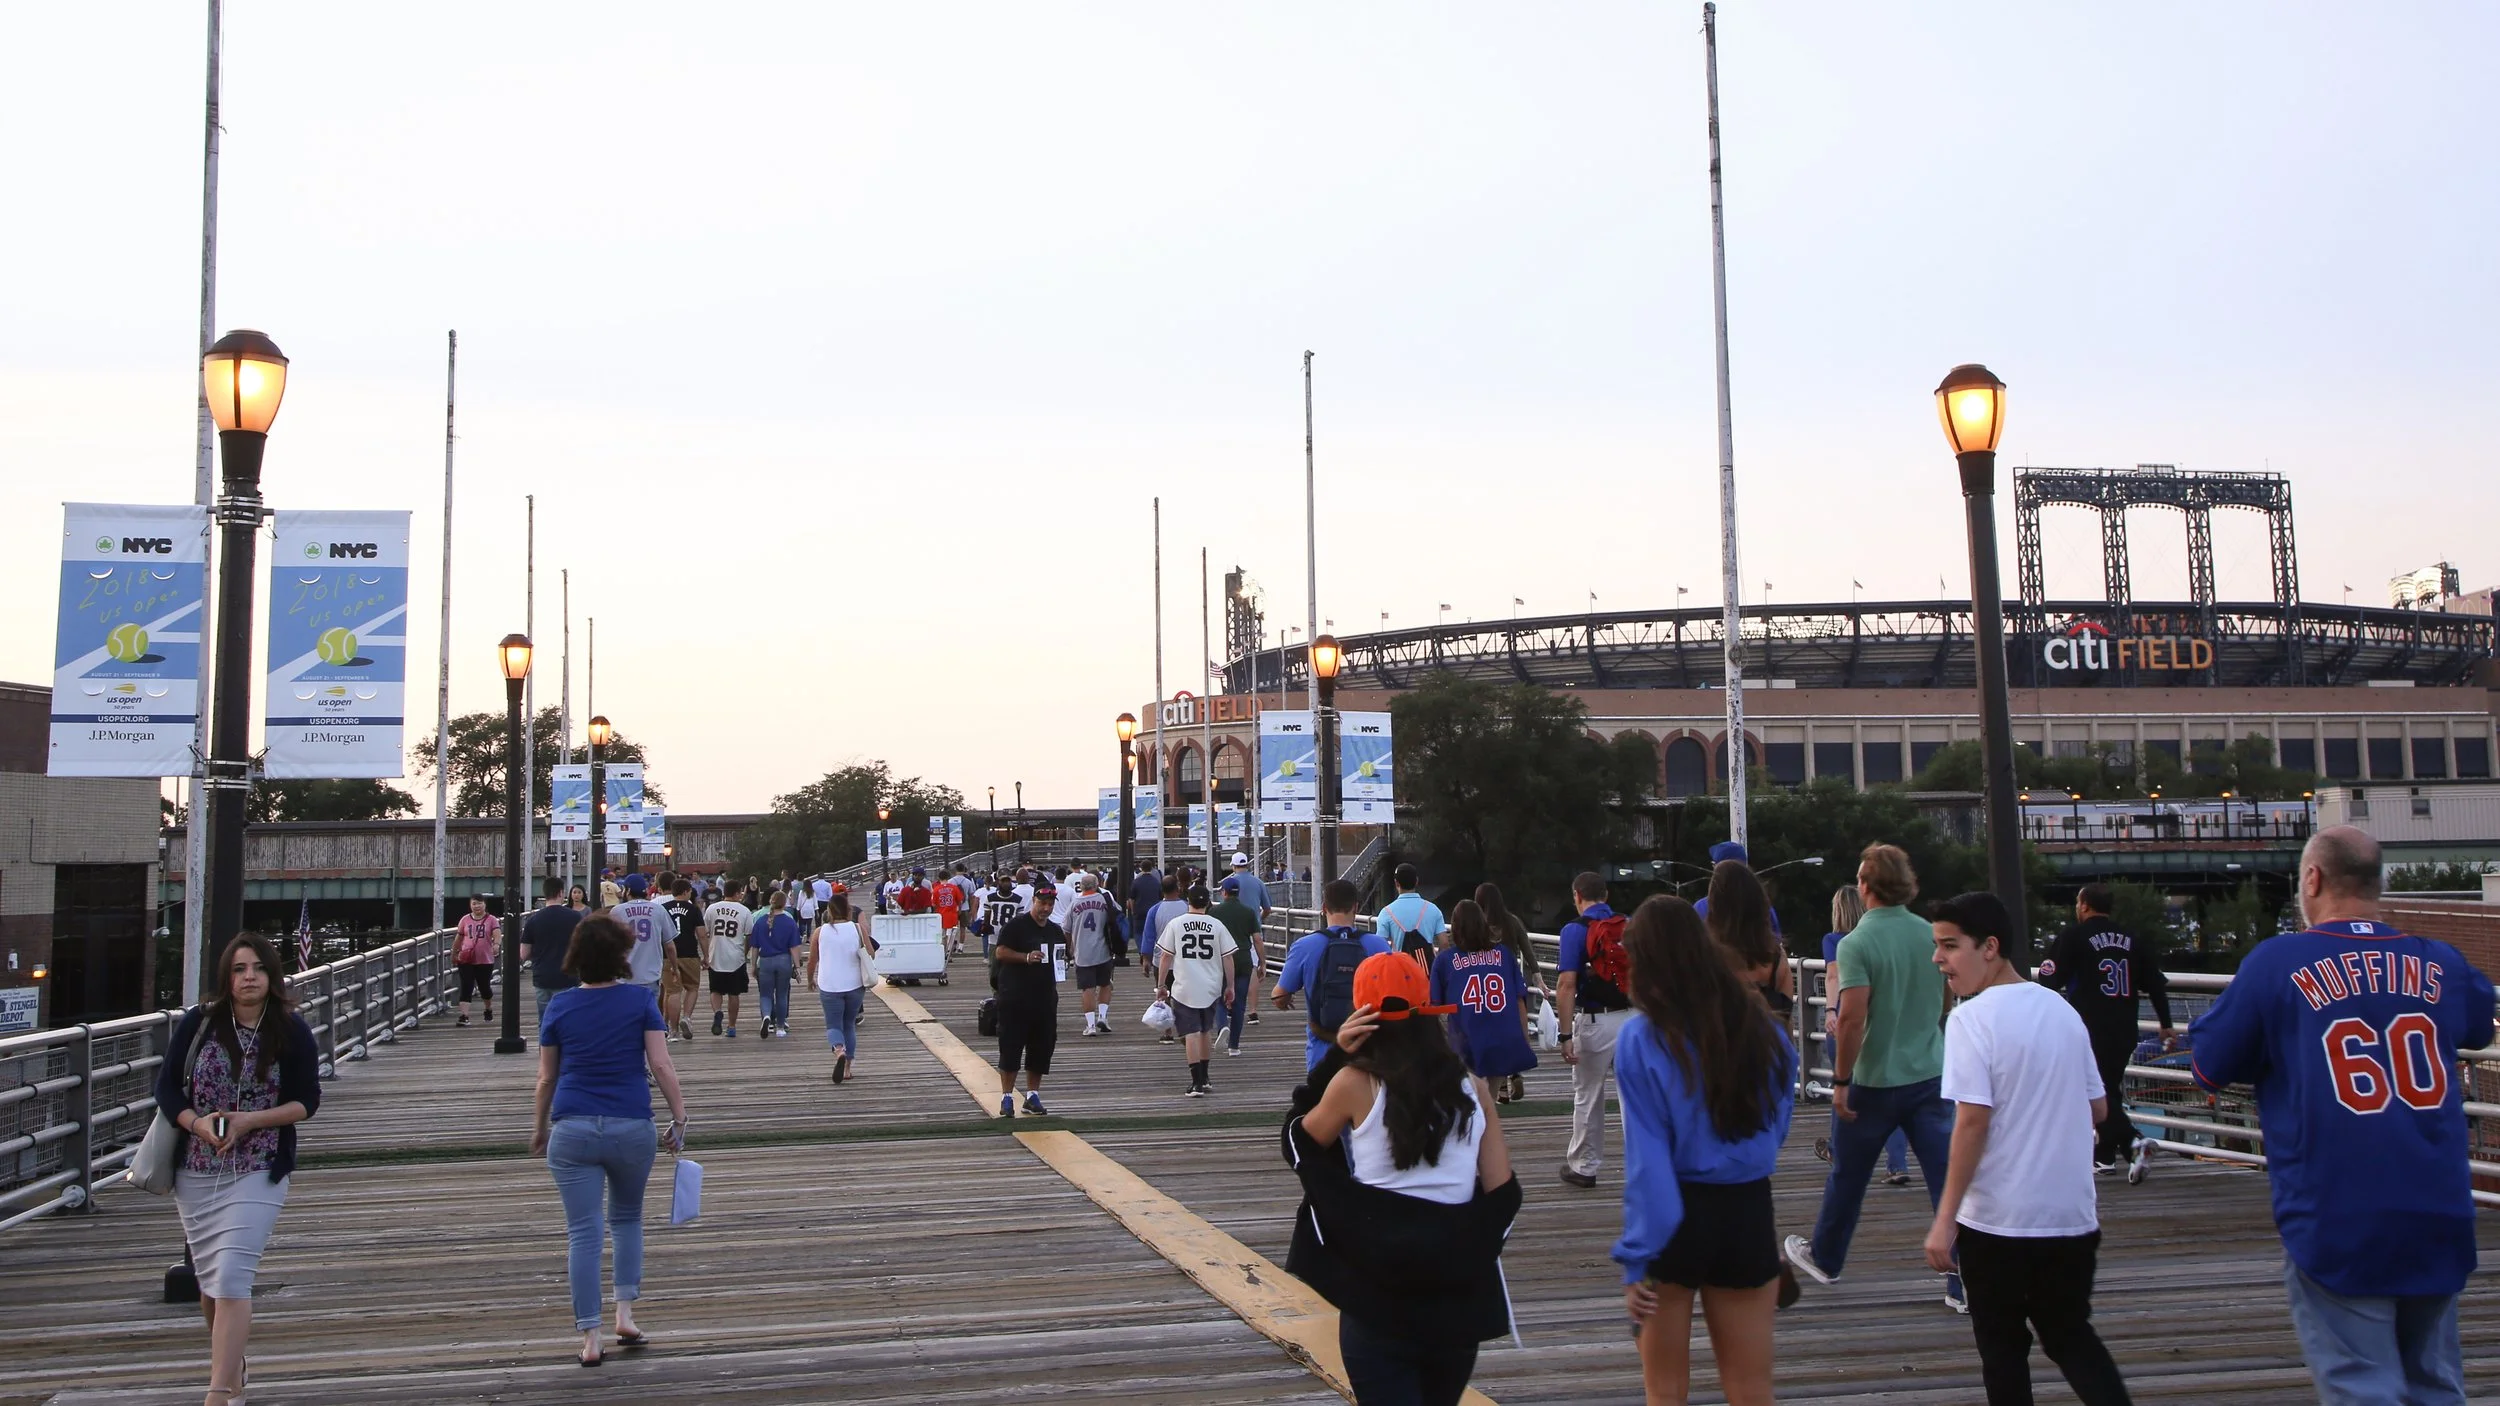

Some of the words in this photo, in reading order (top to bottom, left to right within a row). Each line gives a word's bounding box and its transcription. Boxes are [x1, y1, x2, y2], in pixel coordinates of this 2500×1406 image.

[122, 538, 172, 553] NYC
[329, 543, 377, 558] NYC
[78, 569, 149, 610] 2018
[289, 574, 358, 615] 2018
[134, 591, 178, 613] open
[343, 594, 385, 616] open
[2044, 627, 2109, 670] citi
[2118, 639, 2213, 670] FIELD
[119, 696, 142, 705] open
[329, 699, 352, 707] open
[97, 715, 150, 723] USOPEN.ORG
[1163, 696, 1194, 726] citi
[1198, 697, 1263, 724] FIELD
[939, 894, 953, 907] 33
[625, 906, 654, 917] BRUCE
[716, 908, 739, 918] POSEY
[990, 903, 1018, 927] 18
[714, 919, 738, 938] 28
[1084, 912, 1096, 932] 4
[1183, 921, 1213, 933] BONDS
[1181, 934, 1214, 960] 25
[2088, 932, 2132, 951] PIAZZA
[2099, 958, 2132, 997] 31
[2290, 951, 2444, 1012] MUFFINS
[1461, 973, 1507, 1014] 48
[10, 999, 38, 1011] STENGEL
[1, 1011, 24, 1023] DEPOT
[2321, 1012, 2448, 1116] 60
